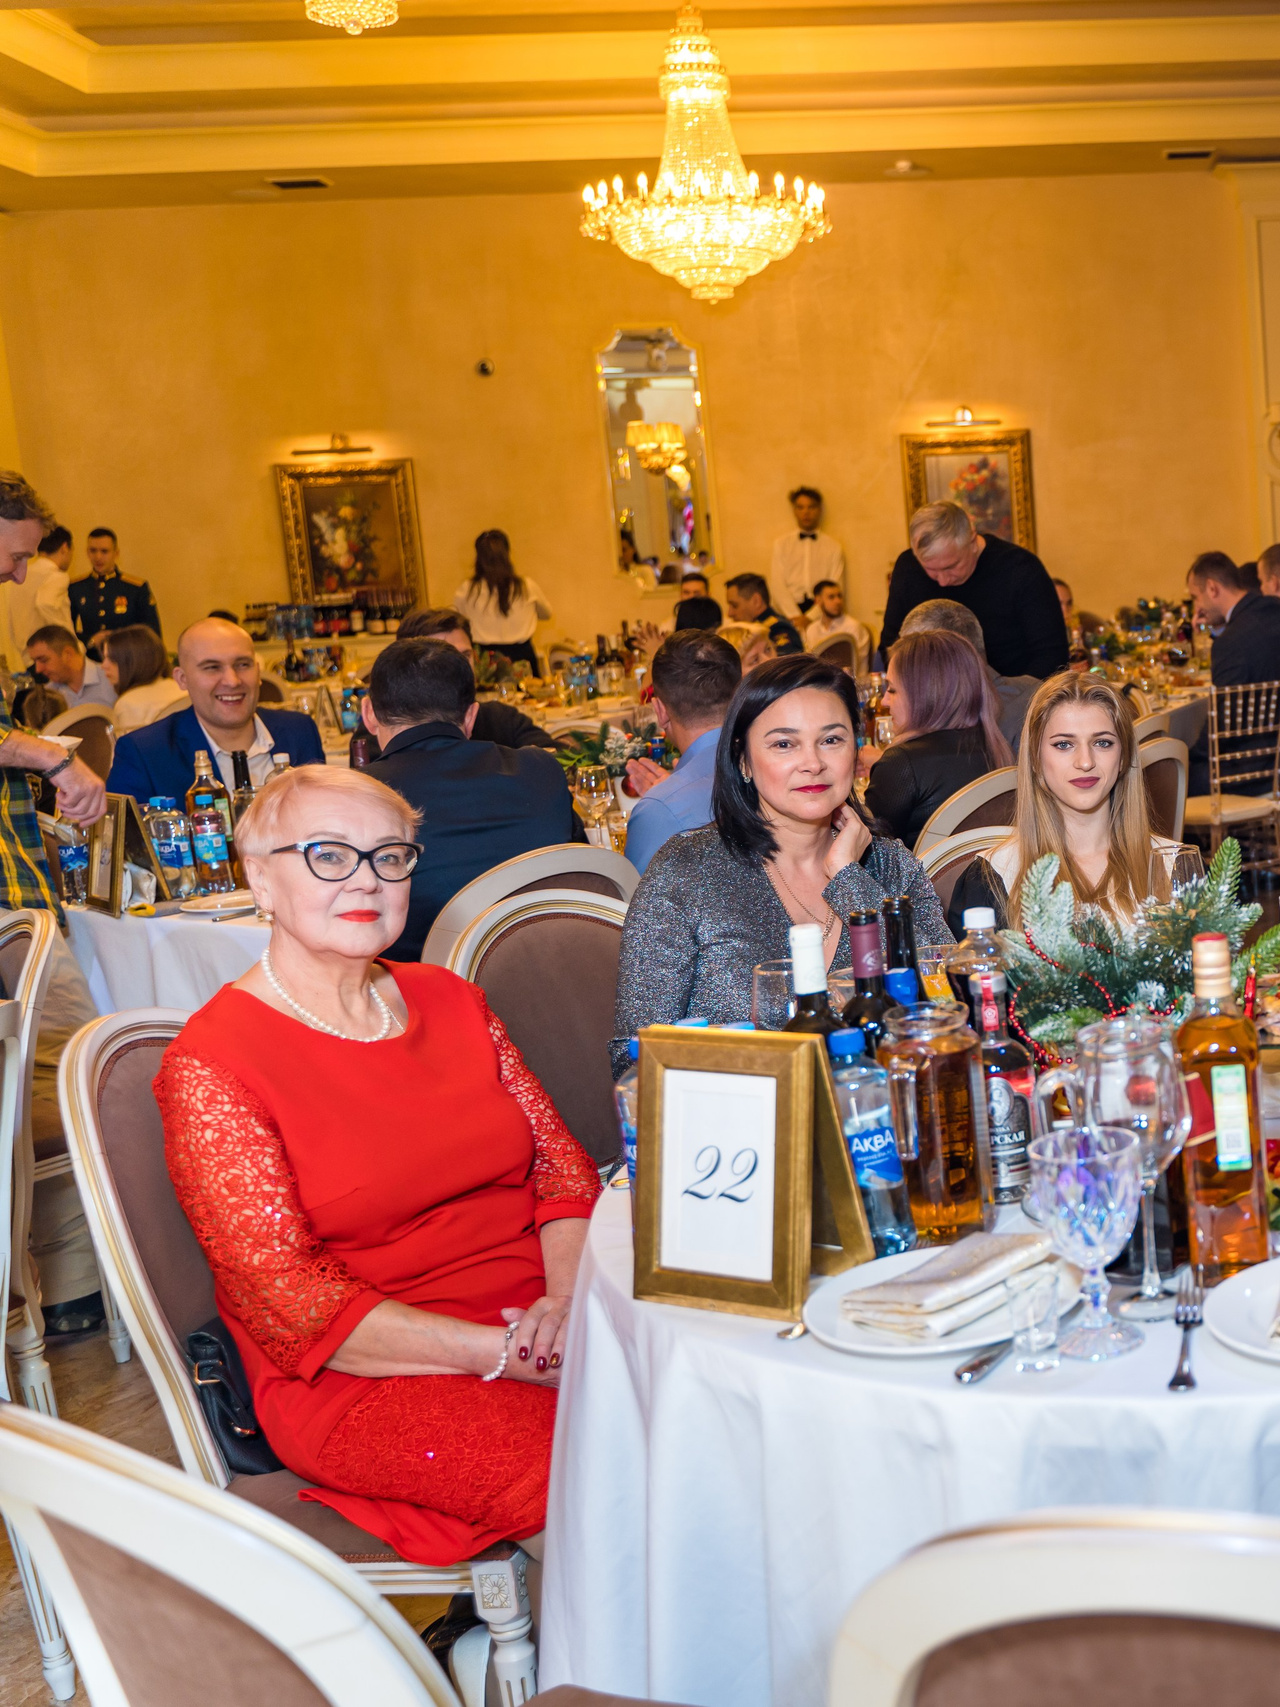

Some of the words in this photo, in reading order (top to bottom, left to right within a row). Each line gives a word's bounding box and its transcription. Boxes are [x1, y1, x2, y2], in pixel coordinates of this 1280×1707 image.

[59, 847, 75, 857] QUA
[159, 844, 177, 854] КВА
[851, 1129, 895, 1154] АКВА
[991, 1130, 1026, 1145] РСКАЯ
[681, 1145, 758, 1203] 22
